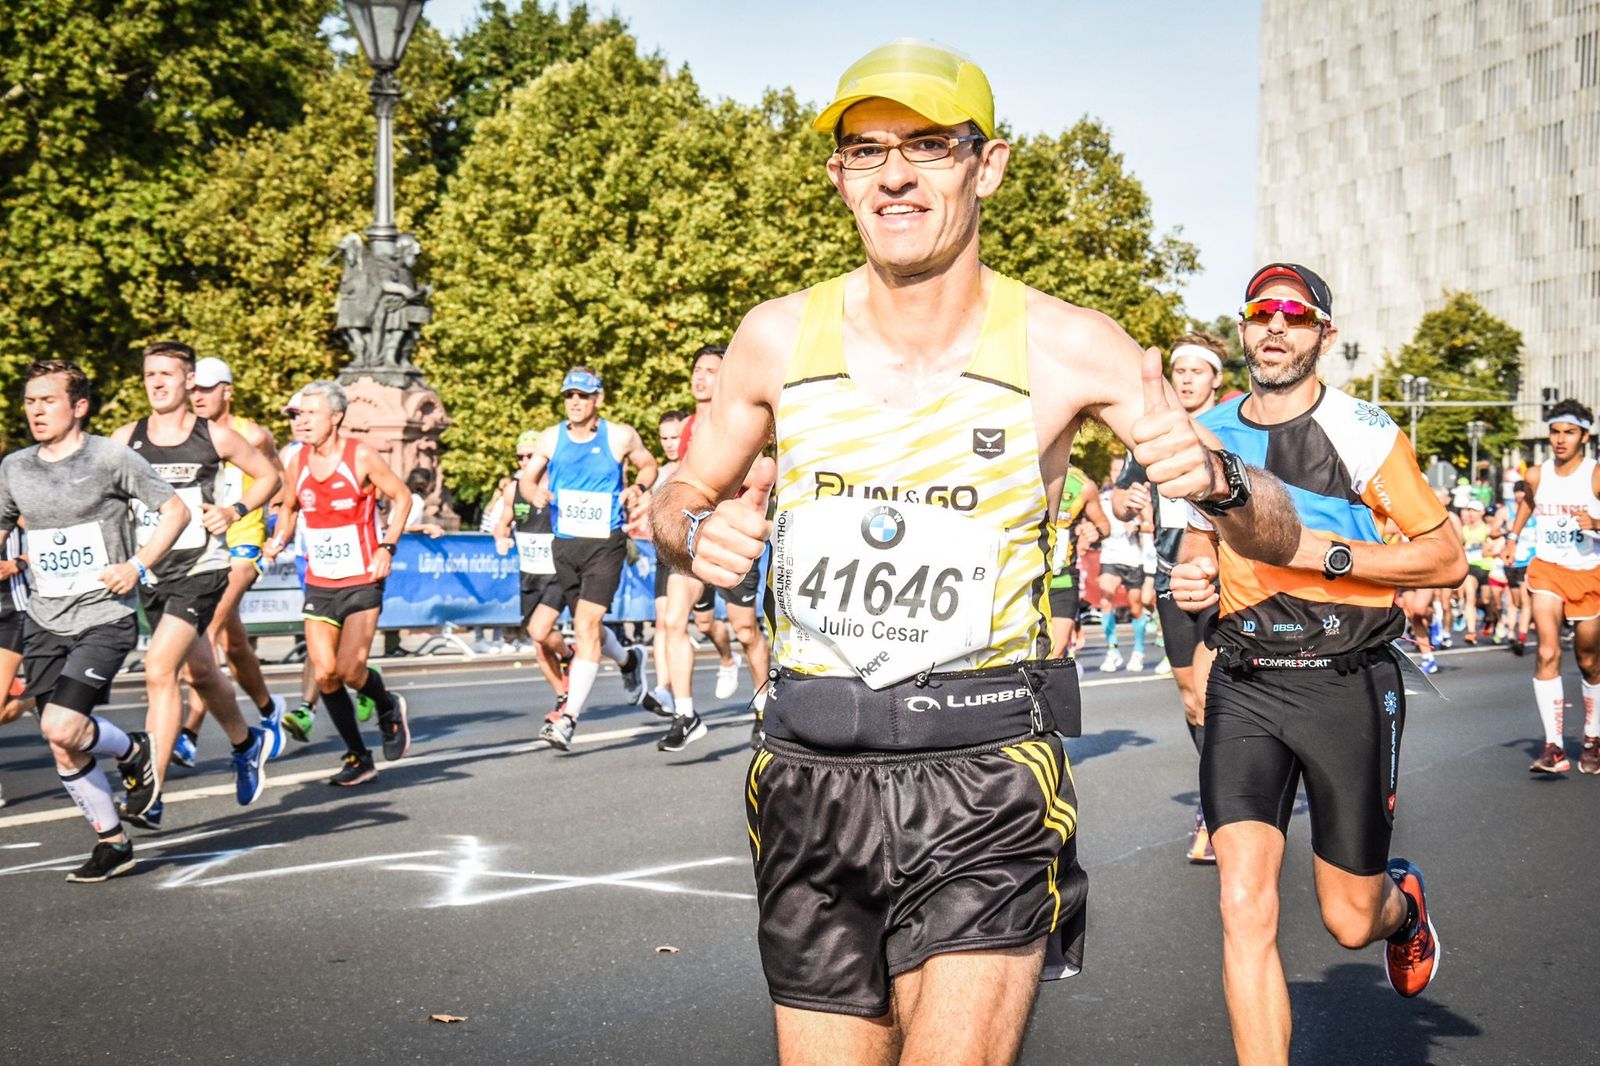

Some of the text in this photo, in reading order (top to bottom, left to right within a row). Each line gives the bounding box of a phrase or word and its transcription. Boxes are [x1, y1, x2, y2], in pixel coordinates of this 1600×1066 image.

[566, 505, 603, 521] 53630
[1545, 529, 1585, 544] 30815
[39, 546, 94, 572] 53505
[972, 566, 986, 581] B
[797, 556, 964, 622] 41646
[819, 616, 865, 638] Julio
[871, 620, 929, 643] Cesar
[855, 650, 890, 679] here
